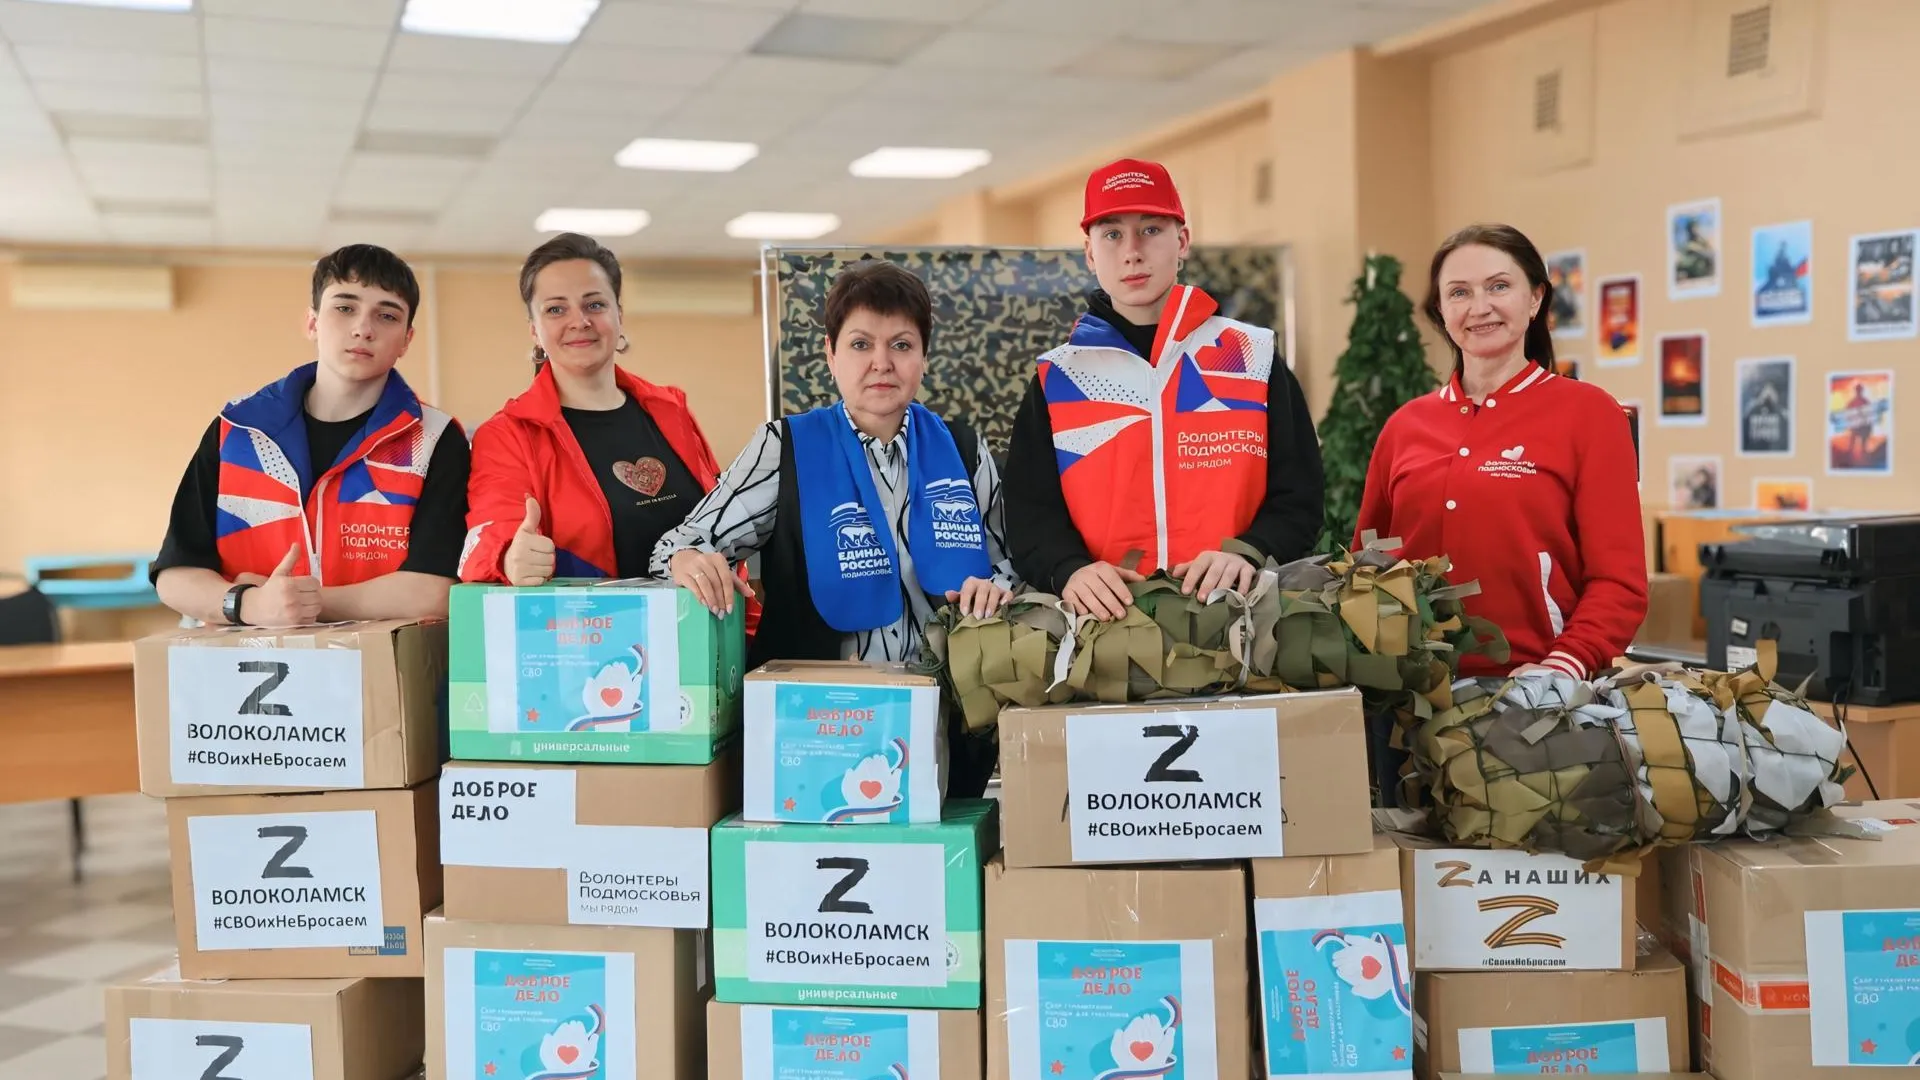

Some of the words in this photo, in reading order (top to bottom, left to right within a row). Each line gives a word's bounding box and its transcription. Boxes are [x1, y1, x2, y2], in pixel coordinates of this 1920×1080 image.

[1178, 443, 1267, 459] ПОДМОСКОВЬ
[1197, 458, 1232, 468] РЯДОМ
[340, 523, 410, 537] ВОЛОНТЕР
[933, 521, 980, 533] ЕДИНАЯ
[341, 536, 409, 550] ПОДМОСК
[935, 531, 982, 543] РОССИЯ
[355, 551, 388, 561] РЯДОМ
[839, 558, 891, 572] РОССИЯ
[841, 567, 893, 579] ПОДМОСКОВЬЕ
[237, 660, 293, 717] Z
[187, 723, 346, 743] ВОЛОКОЛАМСК
[533, 742, 630, 754] универсальные
[1142, 724, 1204, 783] Z
[187, 750, 347, 769] #СВОихНеБросаем
[451, 780, 538, 799] ДОБРОЕ
[1087, 791, 1262, 811] ВОЛОКОЛАМСК
[451, 804, 509, 821] ДЕЛО
[1087, 821, 1263, 839] #СВОихНеБросаем
[257, 825, 314, 879] Z
[816, 856, 874, 914] Z
[211, 886, 366, 906] ВОЛОКОЛАМСК
[580, 904, 598, 914] МЫ
[600, 904, 639, 915] РЯДОМ
[213, 914, 367, 931] #СВОихНеБросаем
[764, 922, 930, 942] ВОЛОКОЛАМСК
[765, 949, 930, 969] #СВОихНеБросаем
[798, 988, 898, 1000] универсальные
[1082, 982, 1132, 996] ДЕЛО
[1854, 992, 1880, 1006] СВО
